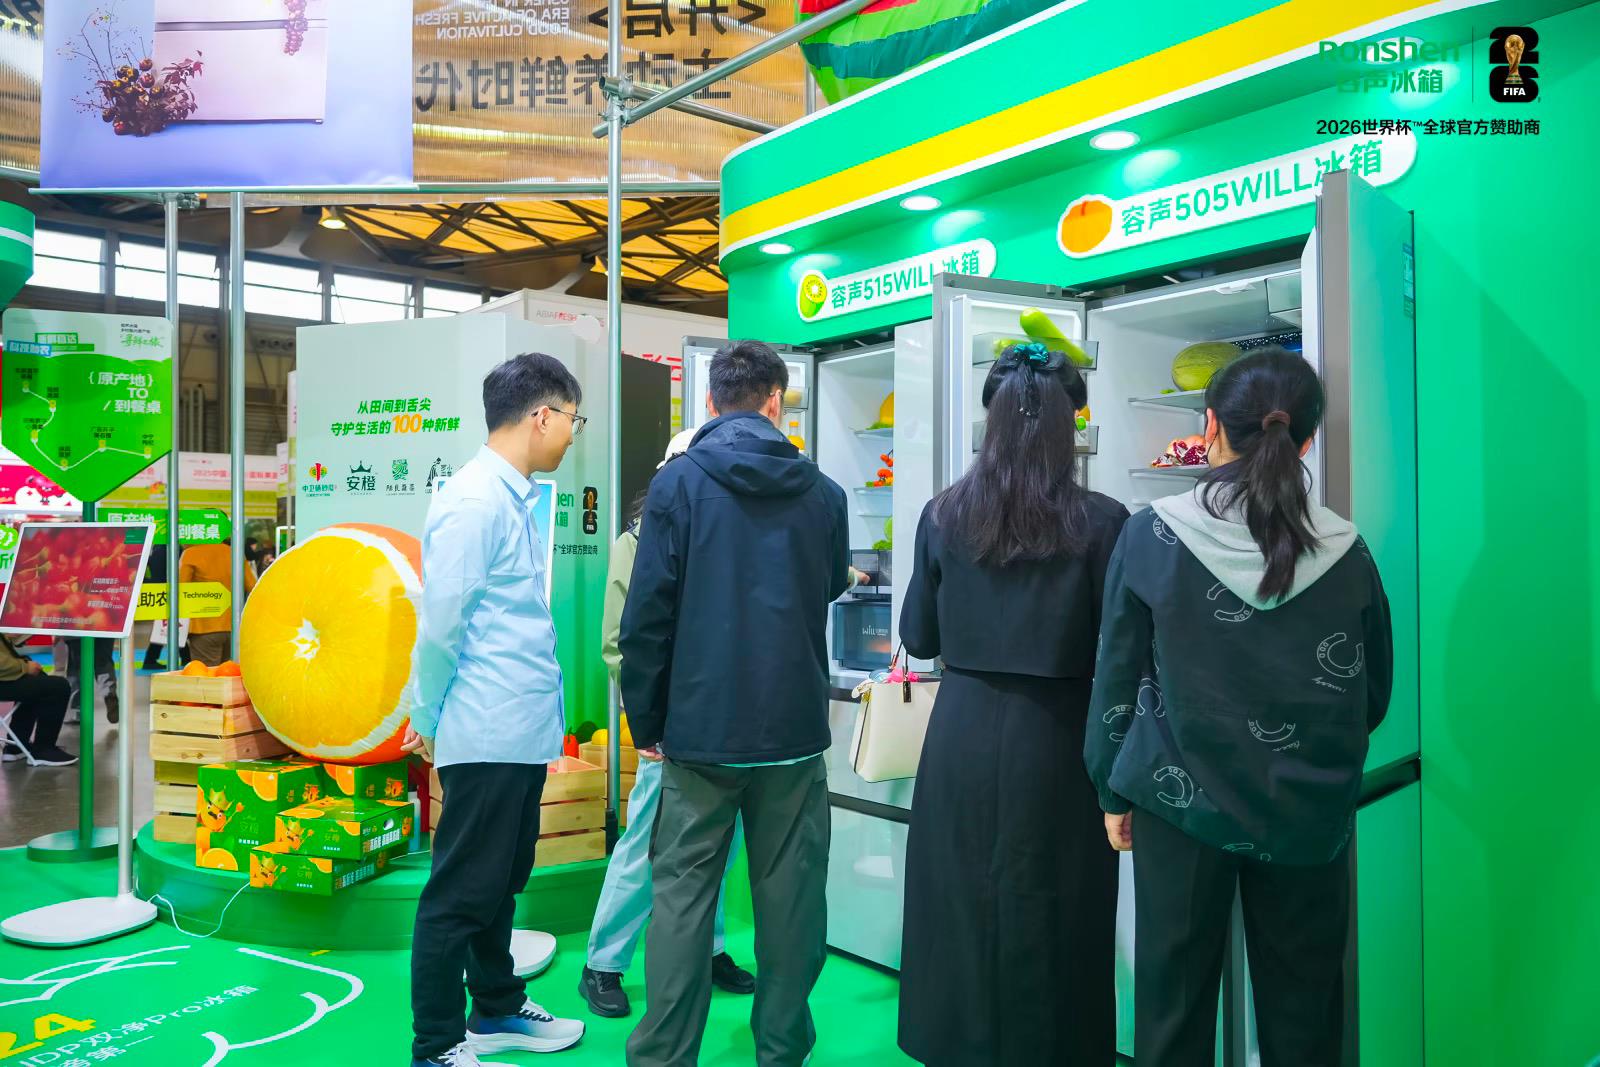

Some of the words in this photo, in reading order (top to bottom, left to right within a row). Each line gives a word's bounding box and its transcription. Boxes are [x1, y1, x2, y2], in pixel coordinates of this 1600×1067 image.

[127, 388, 148, 399] TO
[357, 397, 432, 415] 从田间到舌尖
[346, 475, 376, 492] 安橙
[137, 592, 168, 608] 助农
[183, 591, 223, 600] Technology
